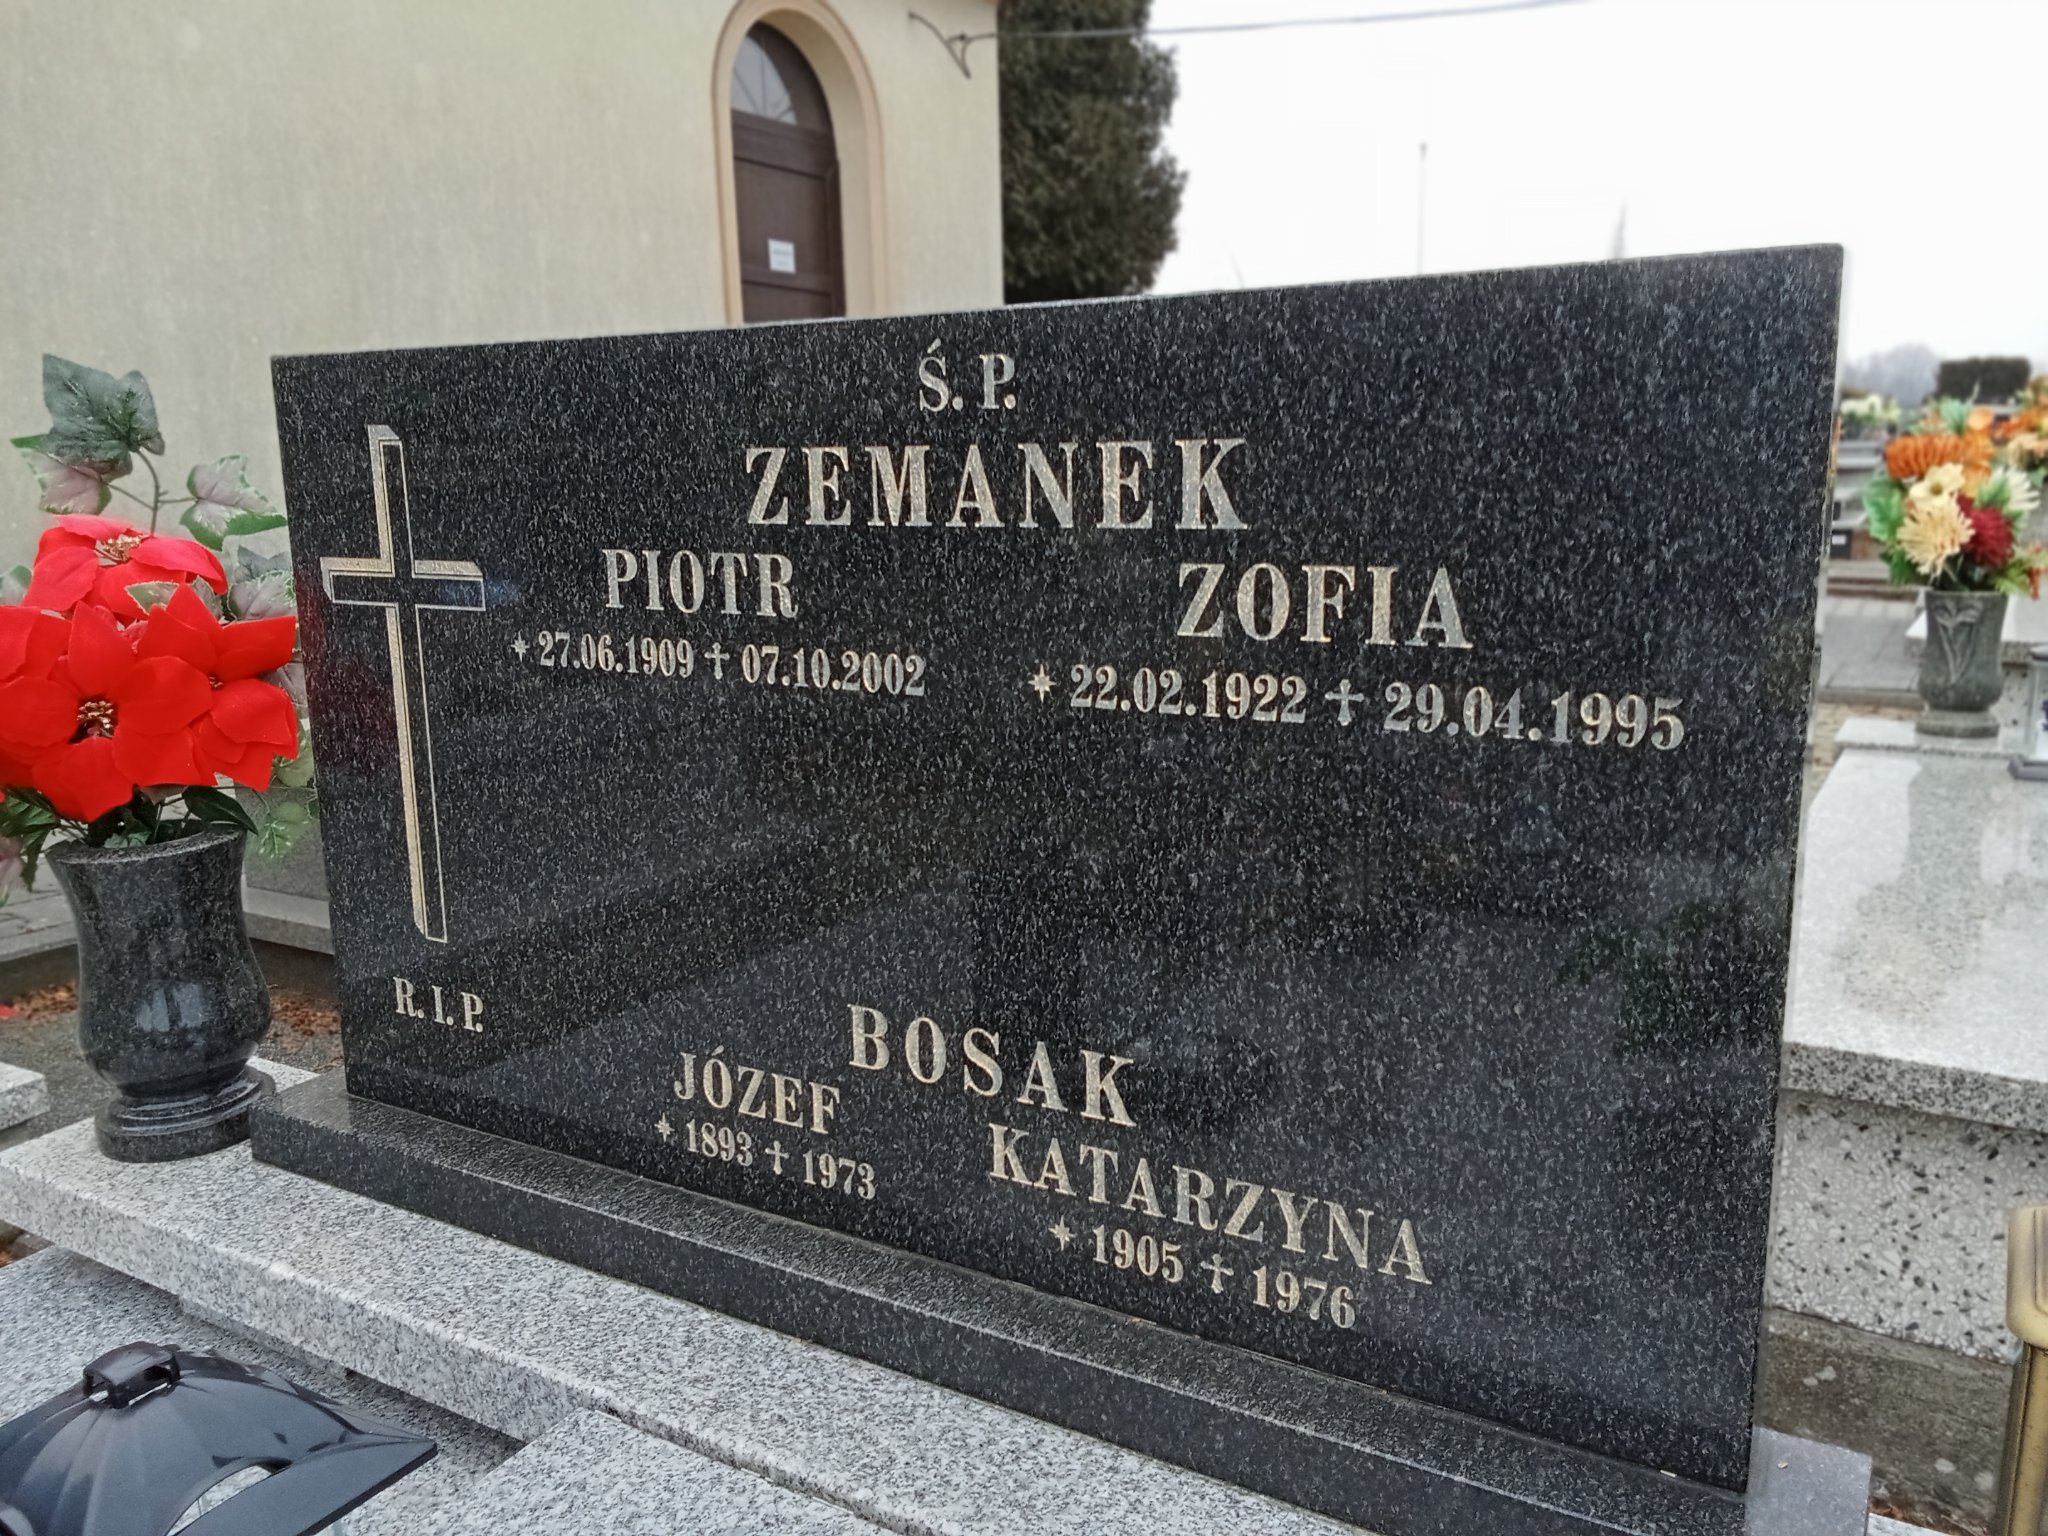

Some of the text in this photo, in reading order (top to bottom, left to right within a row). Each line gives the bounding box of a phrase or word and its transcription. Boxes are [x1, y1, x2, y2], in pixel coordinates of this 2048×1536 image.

[744, 436, 1248, 530] ZEMANEK
[601, 548, 799, 619] PIOTR
[1177, 563, 1474, 650] ZOFIA
[538, 631, 927, 697] 27.06.1909 07.10.2002
[1069, 664, 1687, 751] 22.02.1922 29.04.1995
[674, 1045, 841, 1134] JÓZEF
[846, 1003, 1137, 1127] BOSAK
[686, 1118, 877, 1201] 1893 1973
[988, 1122, 1433, 1286] KATARZYNA
[1091, 1224, 1357, 1330] 1905 1976
